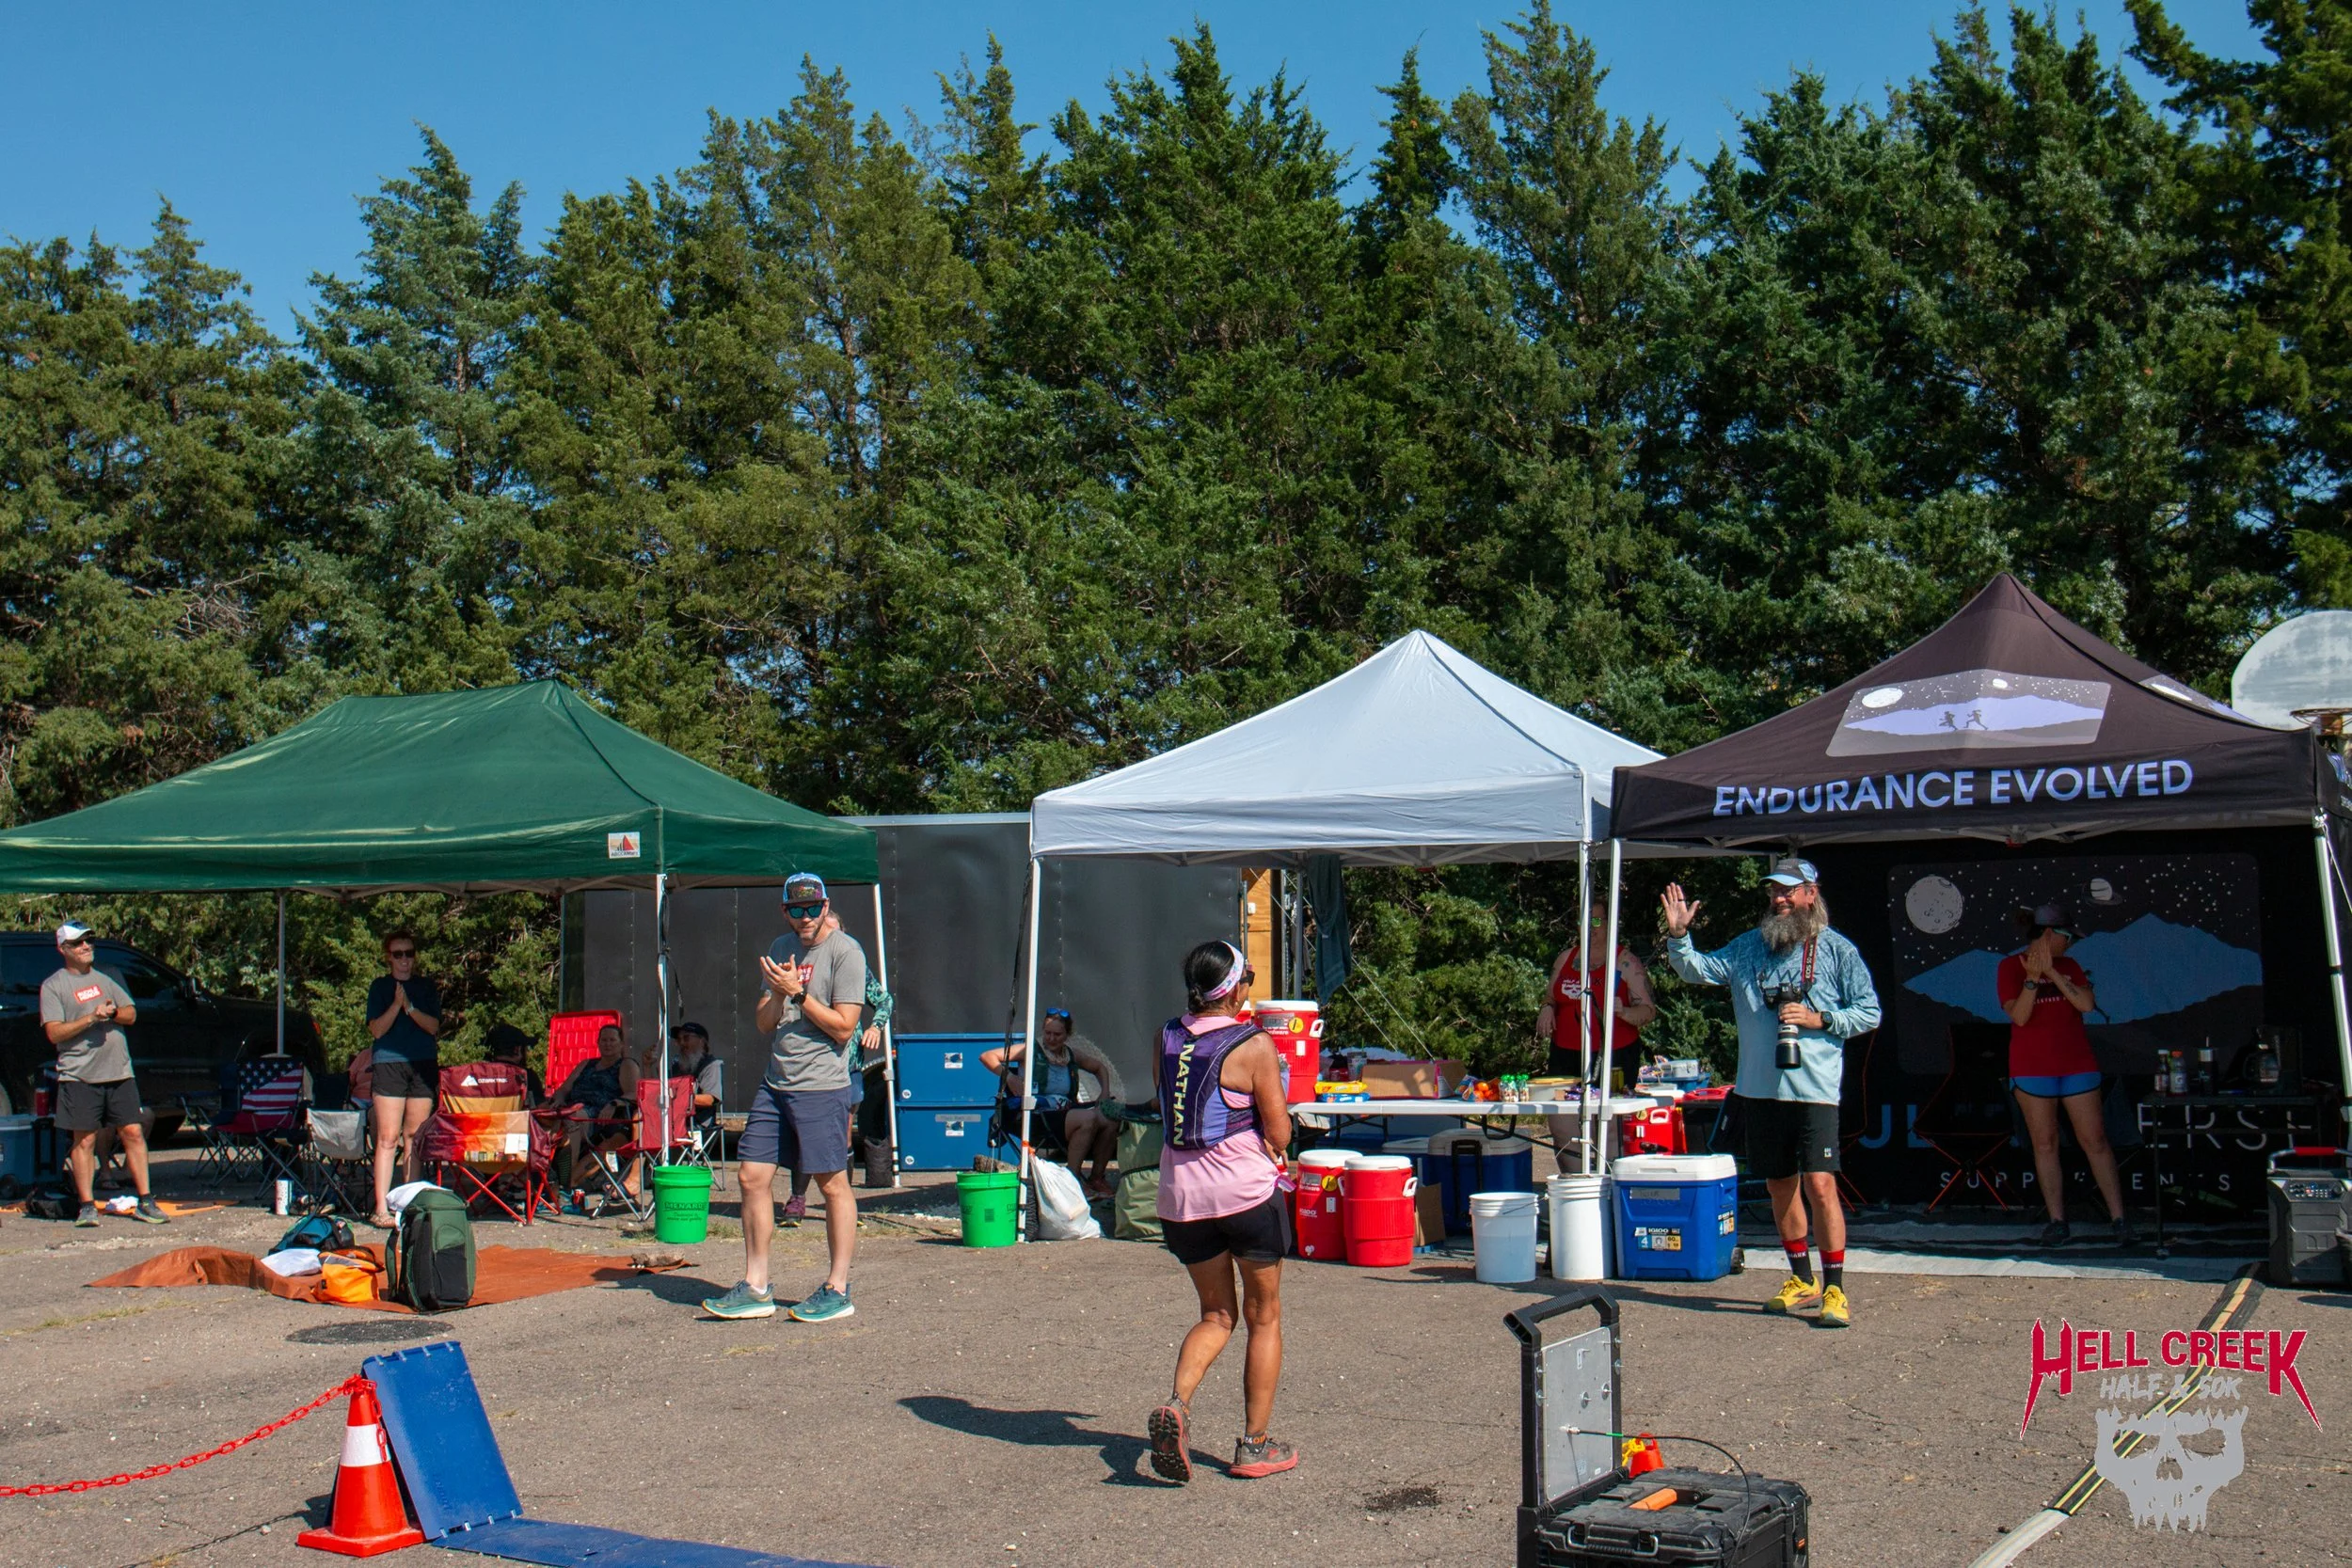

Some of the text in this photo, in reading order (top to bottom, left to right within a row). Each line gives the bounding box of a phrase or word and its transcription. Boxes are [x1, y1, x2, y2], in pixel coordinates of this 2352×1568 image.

[1713, 760, 2193, 816] ENDURANCE EVOLVED
[1173, 1044, 1196, 1146] NATHAN
[1641, 1236, 1648, 1245] 4
